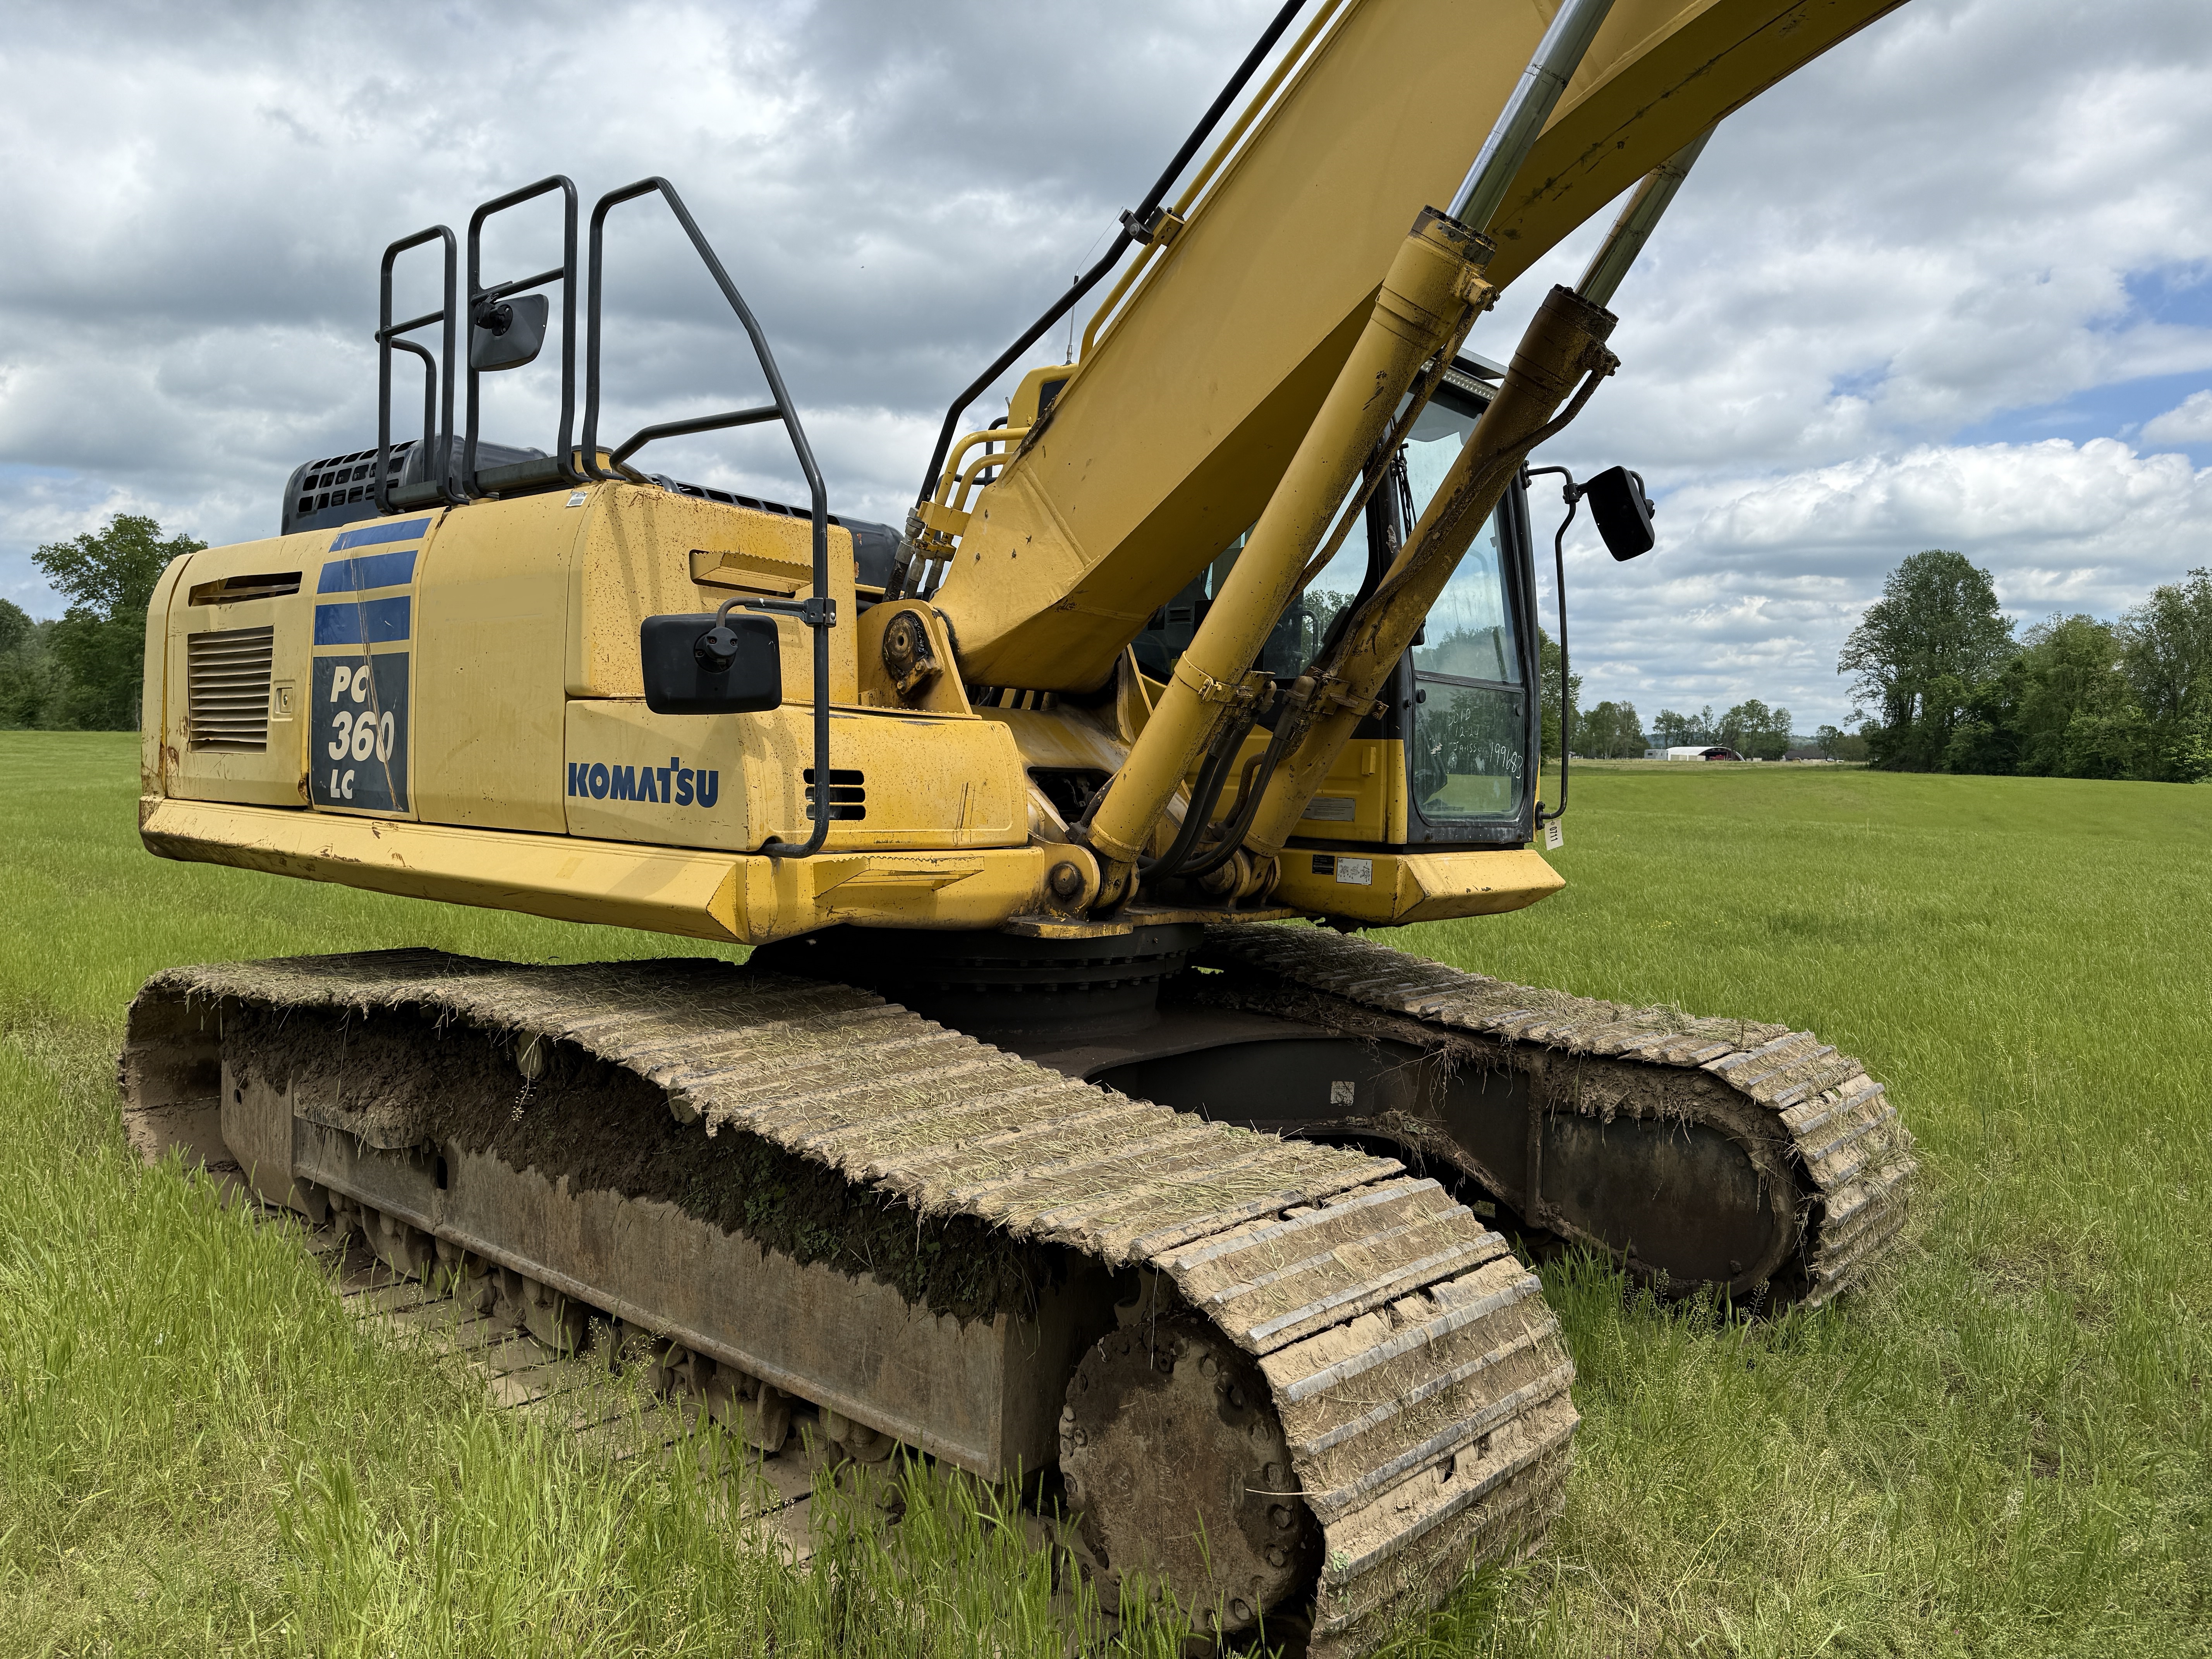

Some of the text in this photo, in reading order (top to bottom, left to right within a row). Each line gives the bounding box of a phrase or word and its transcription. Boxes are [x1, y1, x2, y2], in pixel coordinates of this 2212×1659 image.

[330, 665, 369, 703] PC
[329, 711, 394, 763] 360
[1490, 742, 1523, 779] 199683
[330, 769, 355, 799] LC
[568, 757, 719, 808] KOMATSU
[1549, 826, 1558, 842] 0711
